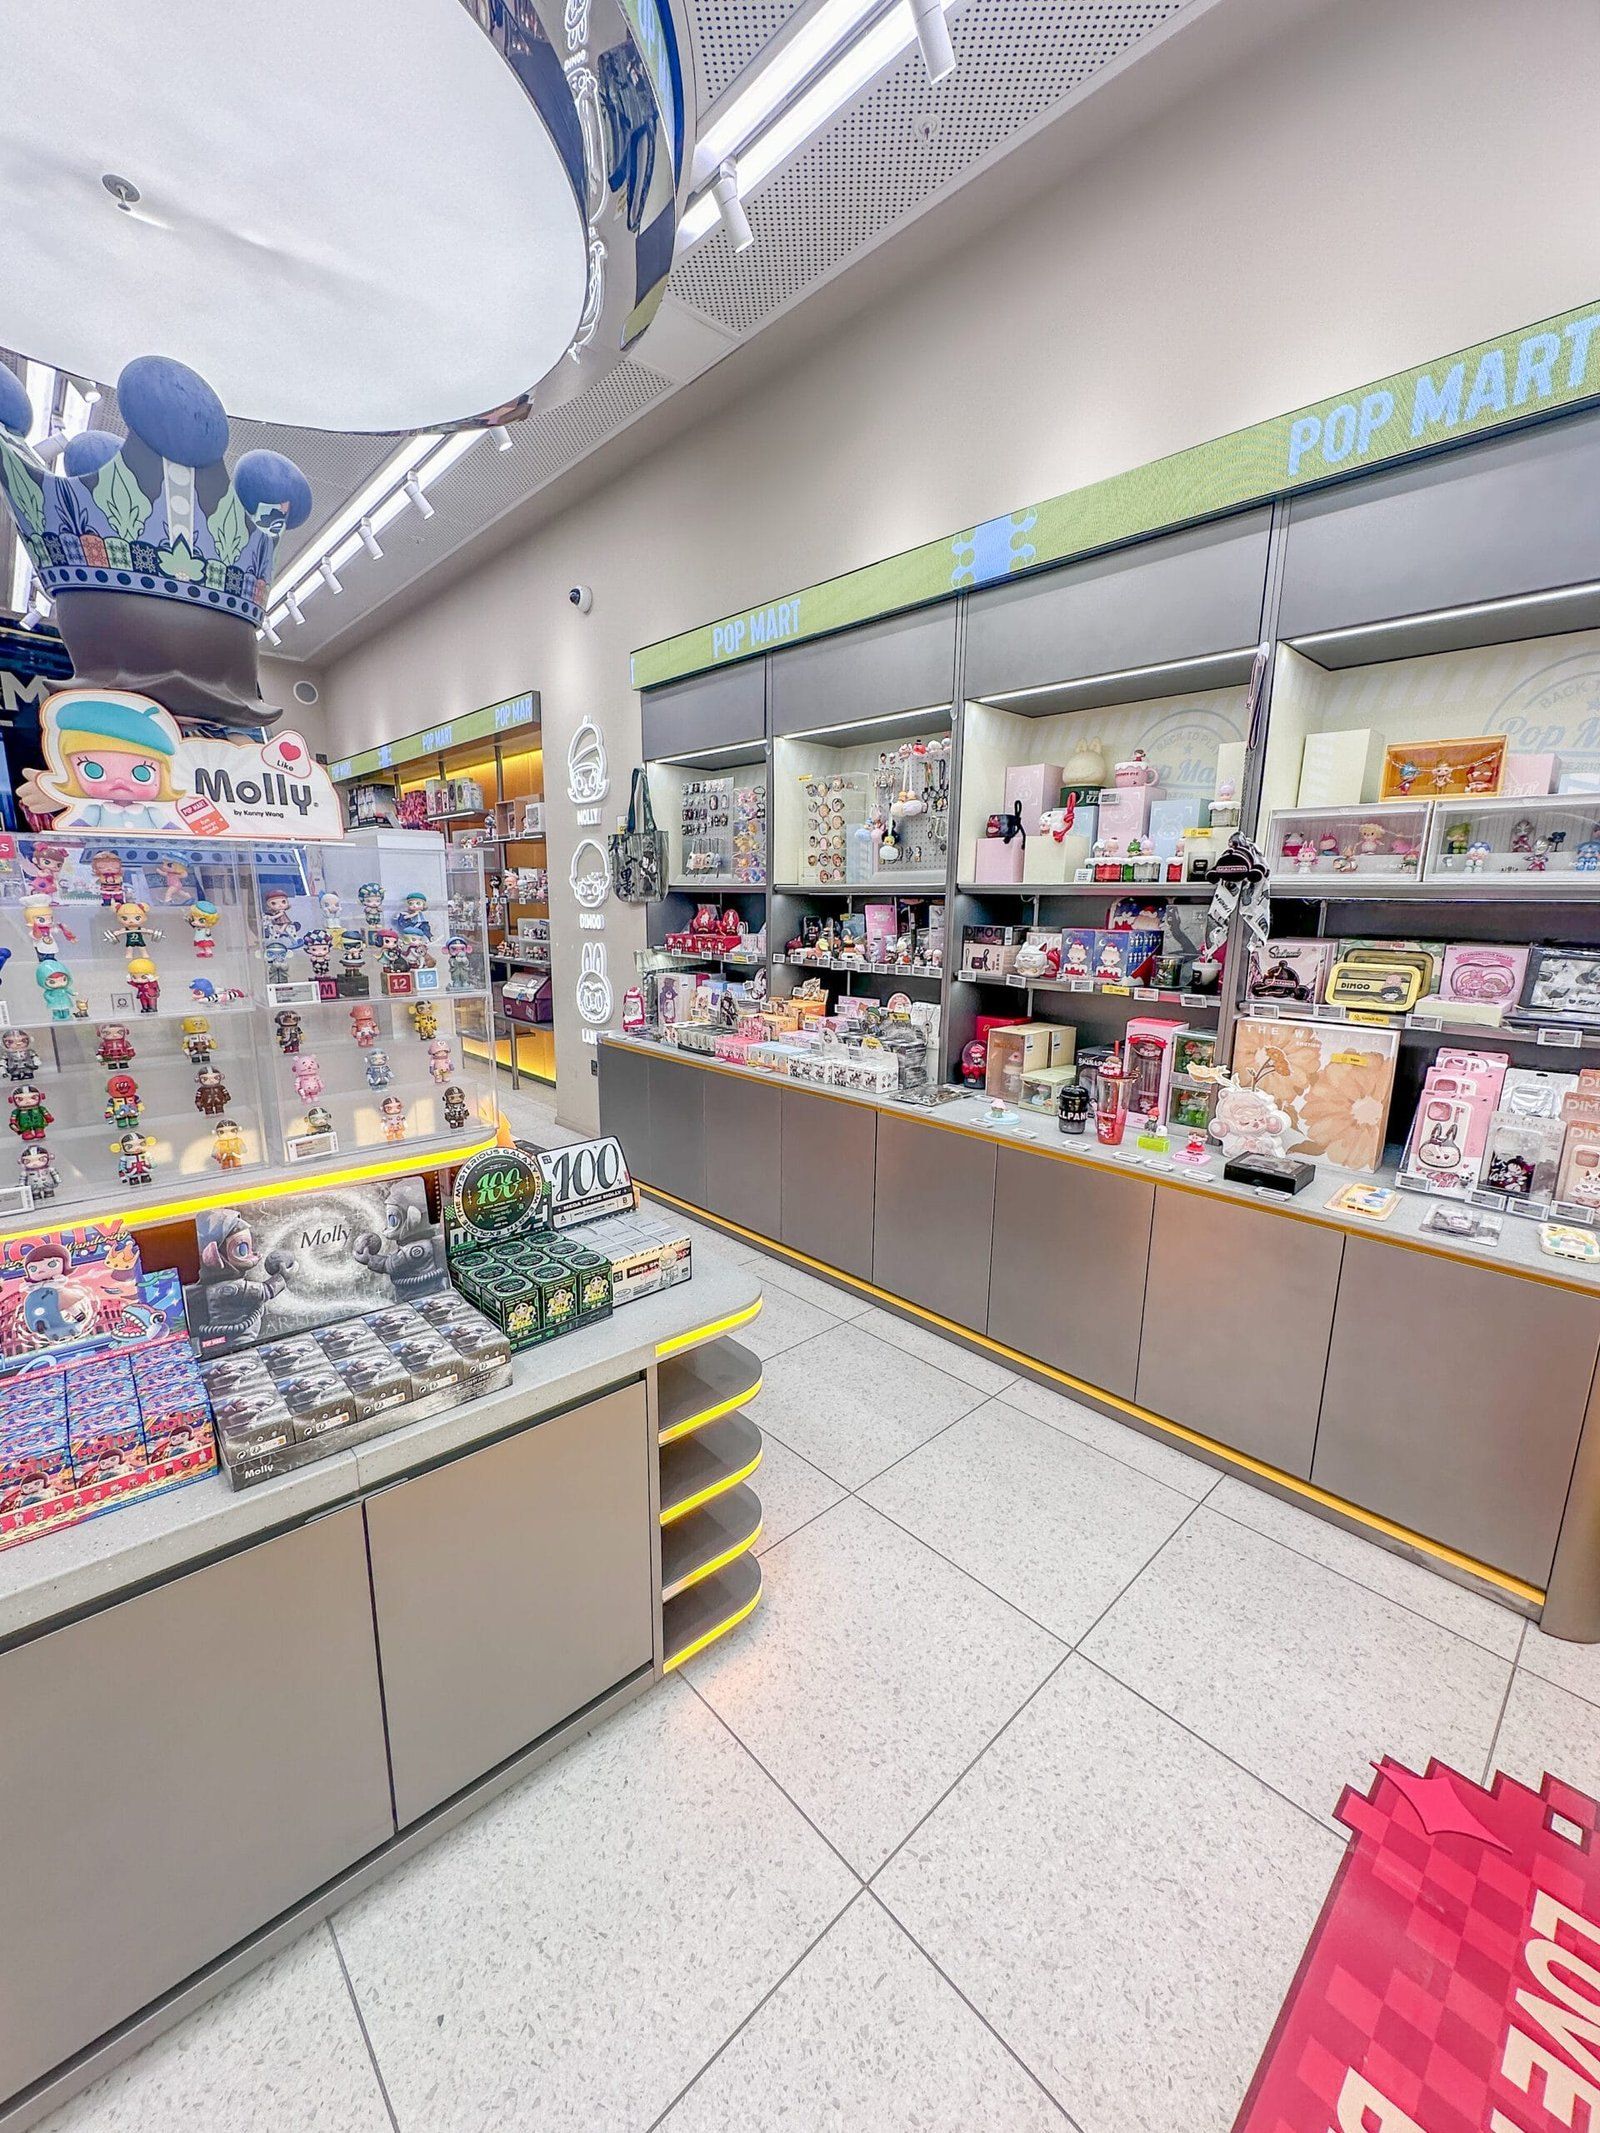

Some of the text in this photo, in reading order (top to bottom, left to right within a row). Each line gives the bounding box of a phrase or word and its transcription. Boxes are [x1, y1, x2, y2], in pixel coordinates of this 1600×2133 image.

[1287, 314, 1600, 477] POP MART
[713, 599, 801, 658] POP MART
[494, 707, 512, 729] POP
[277, 760, 294, 772] Like
[195, 767, 313, 816] Molly
[392, 978, 407, 990] 12
[420, 974, 434, 985] 12
[1340, 982, 1371, 990] DIMOO
[1245, 1024, 1281, 1036] THE
[300, 1224, 352, 1249] Molly
[244, 1463, 275, 1479] Molly
